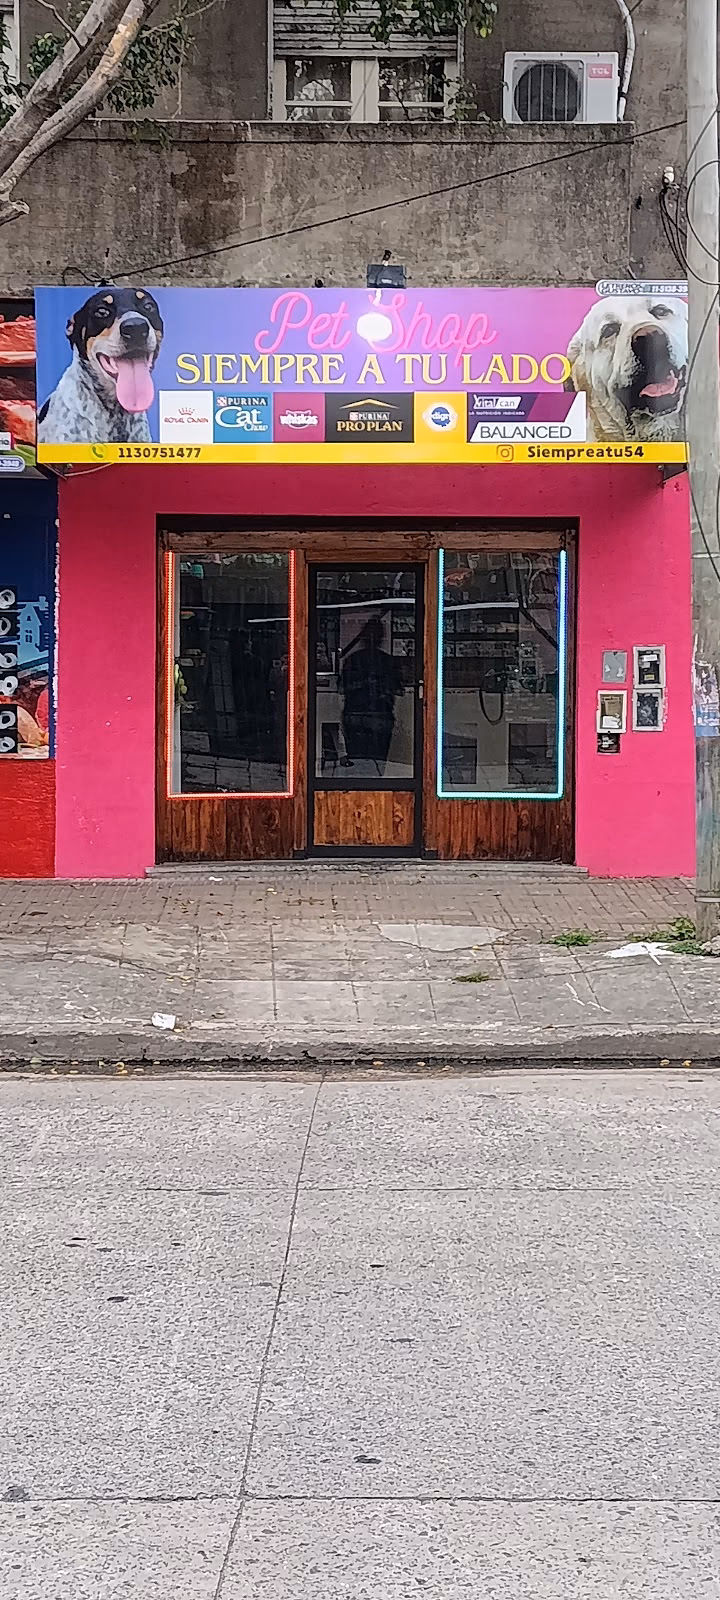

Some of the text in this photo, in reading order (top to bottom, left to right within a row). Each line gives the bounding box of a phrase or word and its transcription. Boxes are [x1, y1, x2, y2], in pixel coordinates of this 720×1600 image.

[591, 67, 610, 75] TCL
[254, 291, 498, 368] Pet Shop
[176, 353, 572, 385] SIEMPRE A TU LADO
[227, 397, 267, 407] PURINA
[215, 406, 263, 428] Cat
[358, 411, 390, 420] PURINA
[336, 421, 403, 432] PRO PLAN
[480, 426, 572, 439] BALANCED
[118, 447, 202, 458] 1130751477
[528, 445, 645, 461] Siempreatu54
